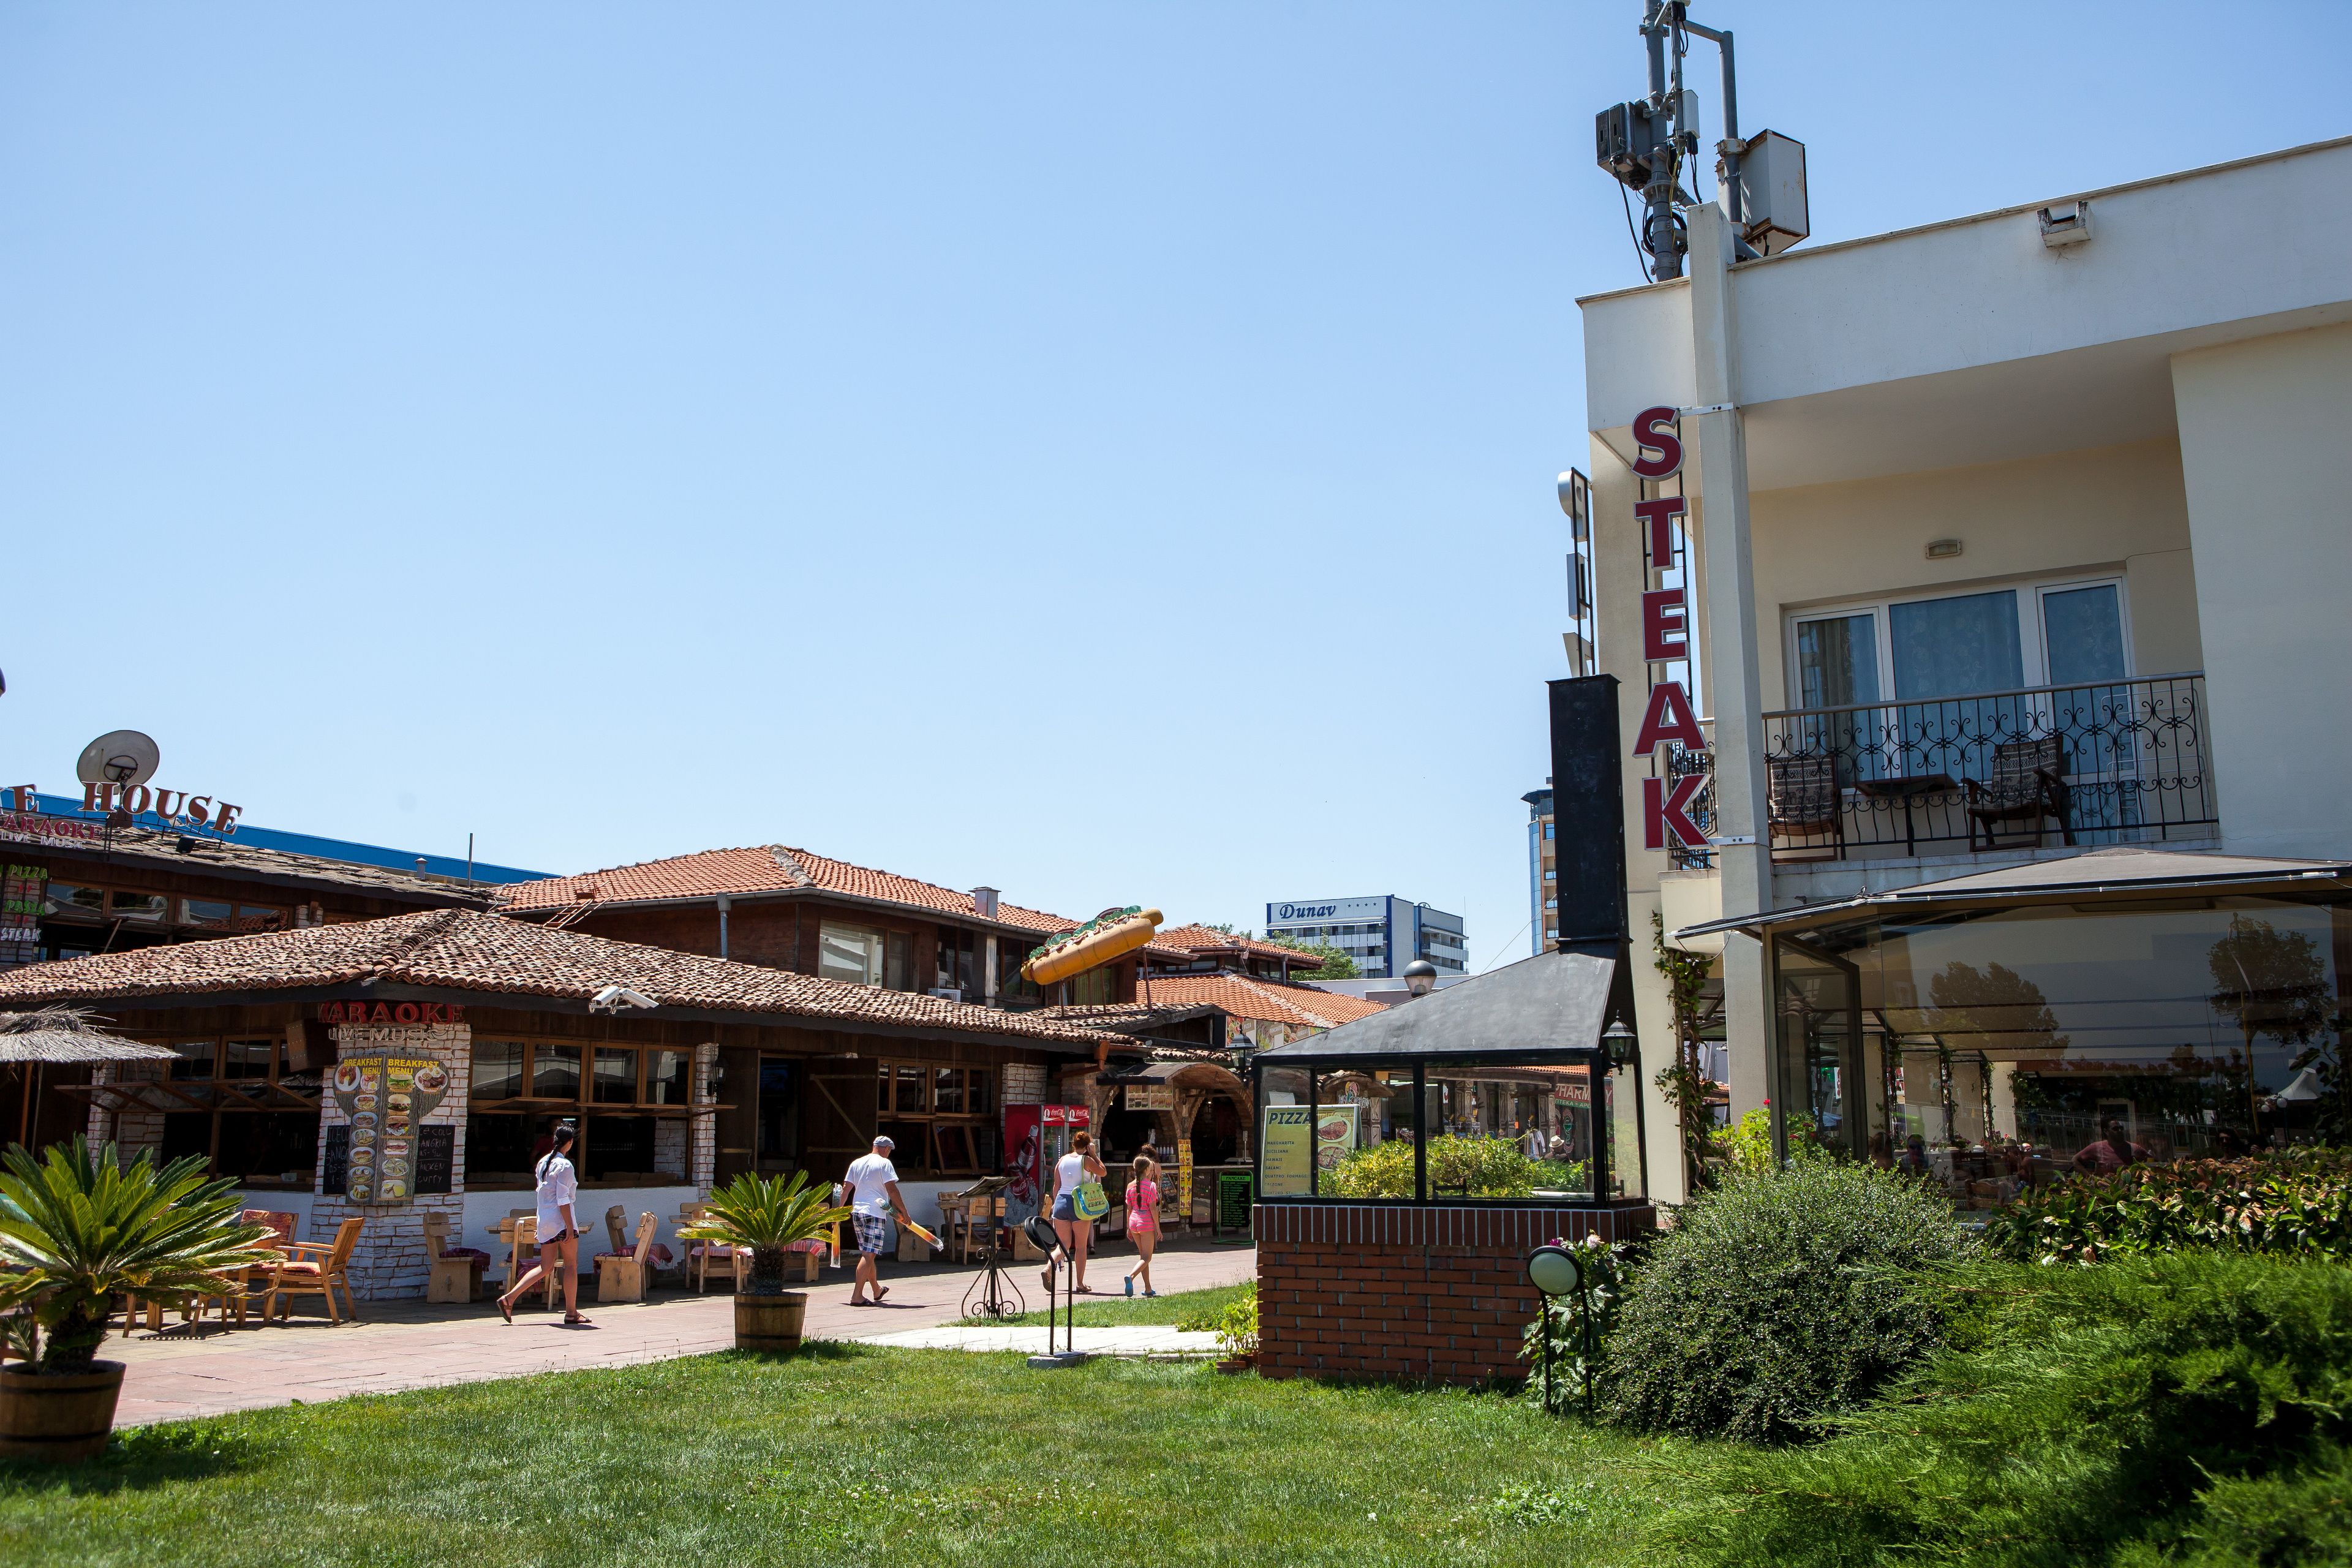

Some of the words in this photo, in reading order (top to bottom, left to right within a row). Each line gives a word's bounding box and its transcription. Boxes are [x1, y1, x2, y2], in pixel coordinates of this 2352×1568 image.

[1630, 405, 1713, 851] STEAK
[77, 781, 243, 835] HOUSE
[2, 814, 104, 841] ARAOKE
[40, 836, 86, 850] MUSIC
[9, 864, 48, 880] PIZZA
[5, 900, 47, 916] PASTA
[1280, 903, 1336, 919] Dunav
[1, 927, 42, 942] STEAK
[317, 1001, 466, 1024] KARAOKE
[369, 1028, 440, 1041] MUSIC
[344, 1058, 383, 1067] BREAKFAST
[388, 1058, 439, 1069] BREAKFAST
[388, 1067, 413, 1076] MENU
[1268, 1112, 1311, 1125] PIZZA
[418, 1138, 447, 1148] ANGRIA
